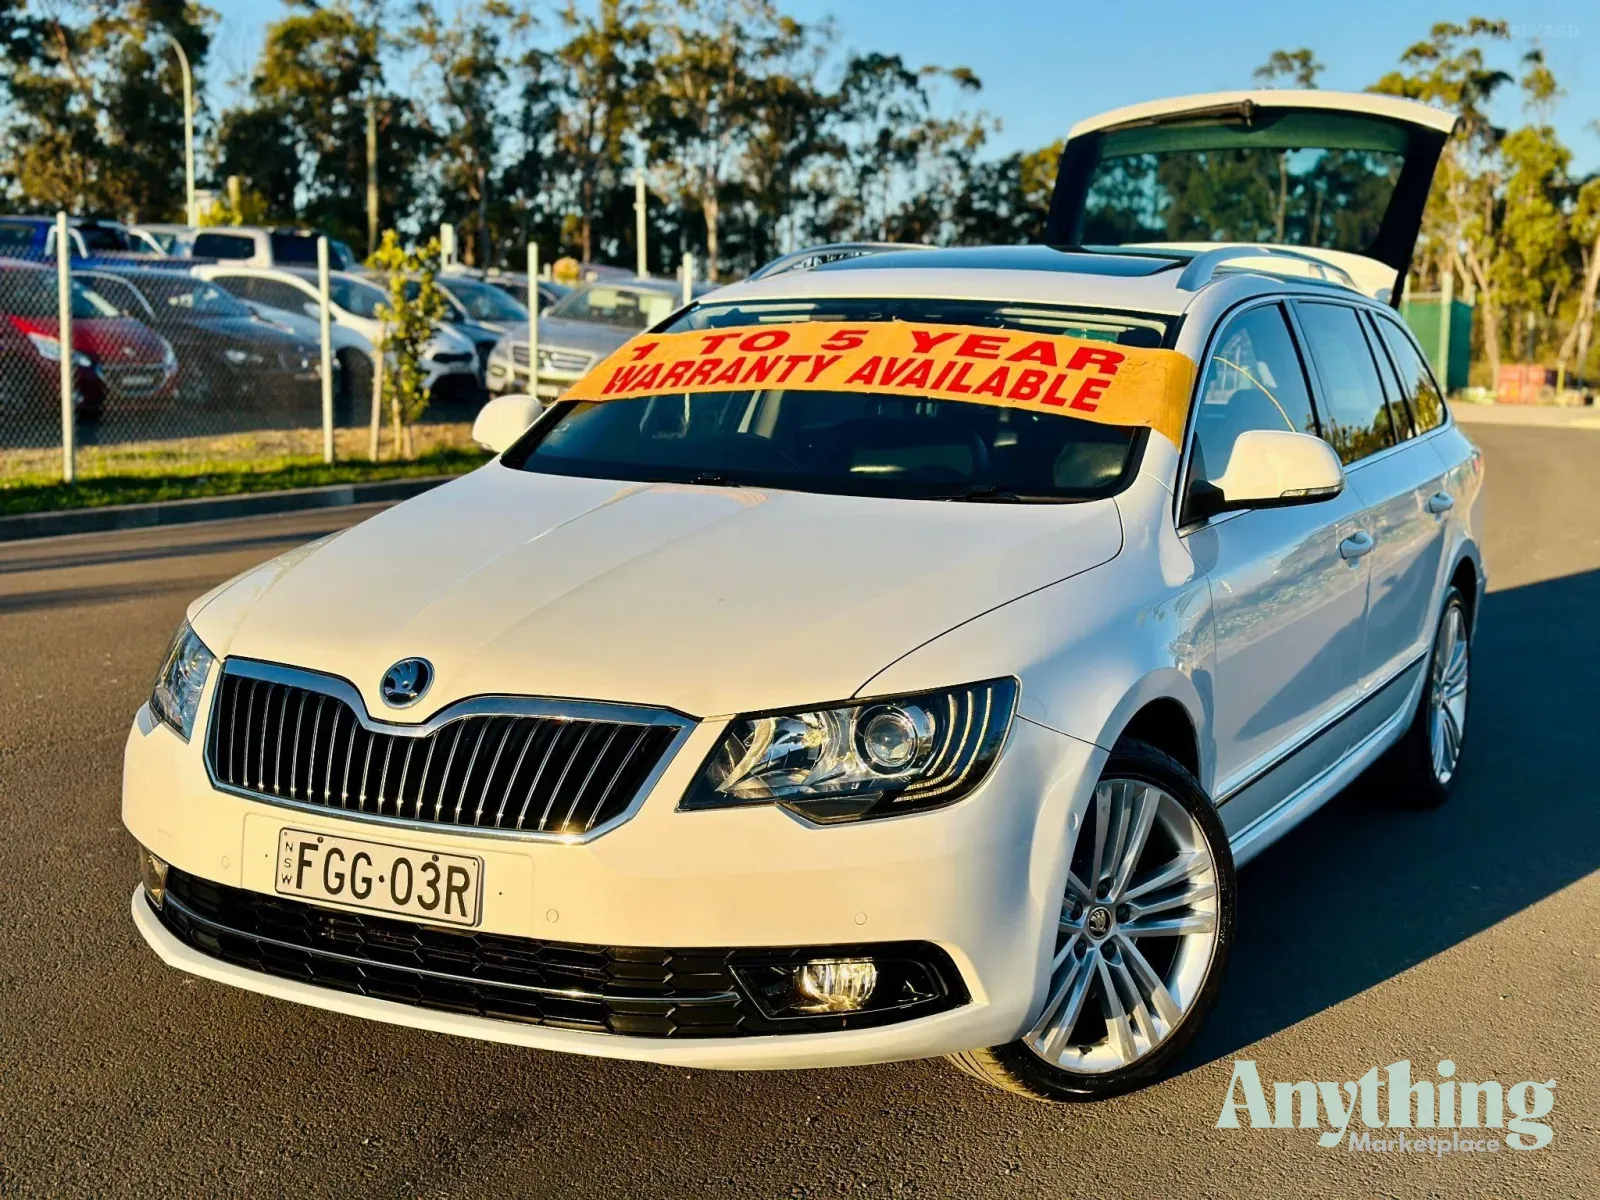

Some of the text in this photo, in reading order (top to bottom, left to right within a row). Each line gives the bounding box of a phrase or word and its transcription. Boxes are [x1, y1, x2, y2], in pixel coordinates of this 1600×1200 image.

[631, 330, 1126, 375] 1 TO 5 YEAR
[601, 354, 1111, 413] WARRANTY AVAILABLE
